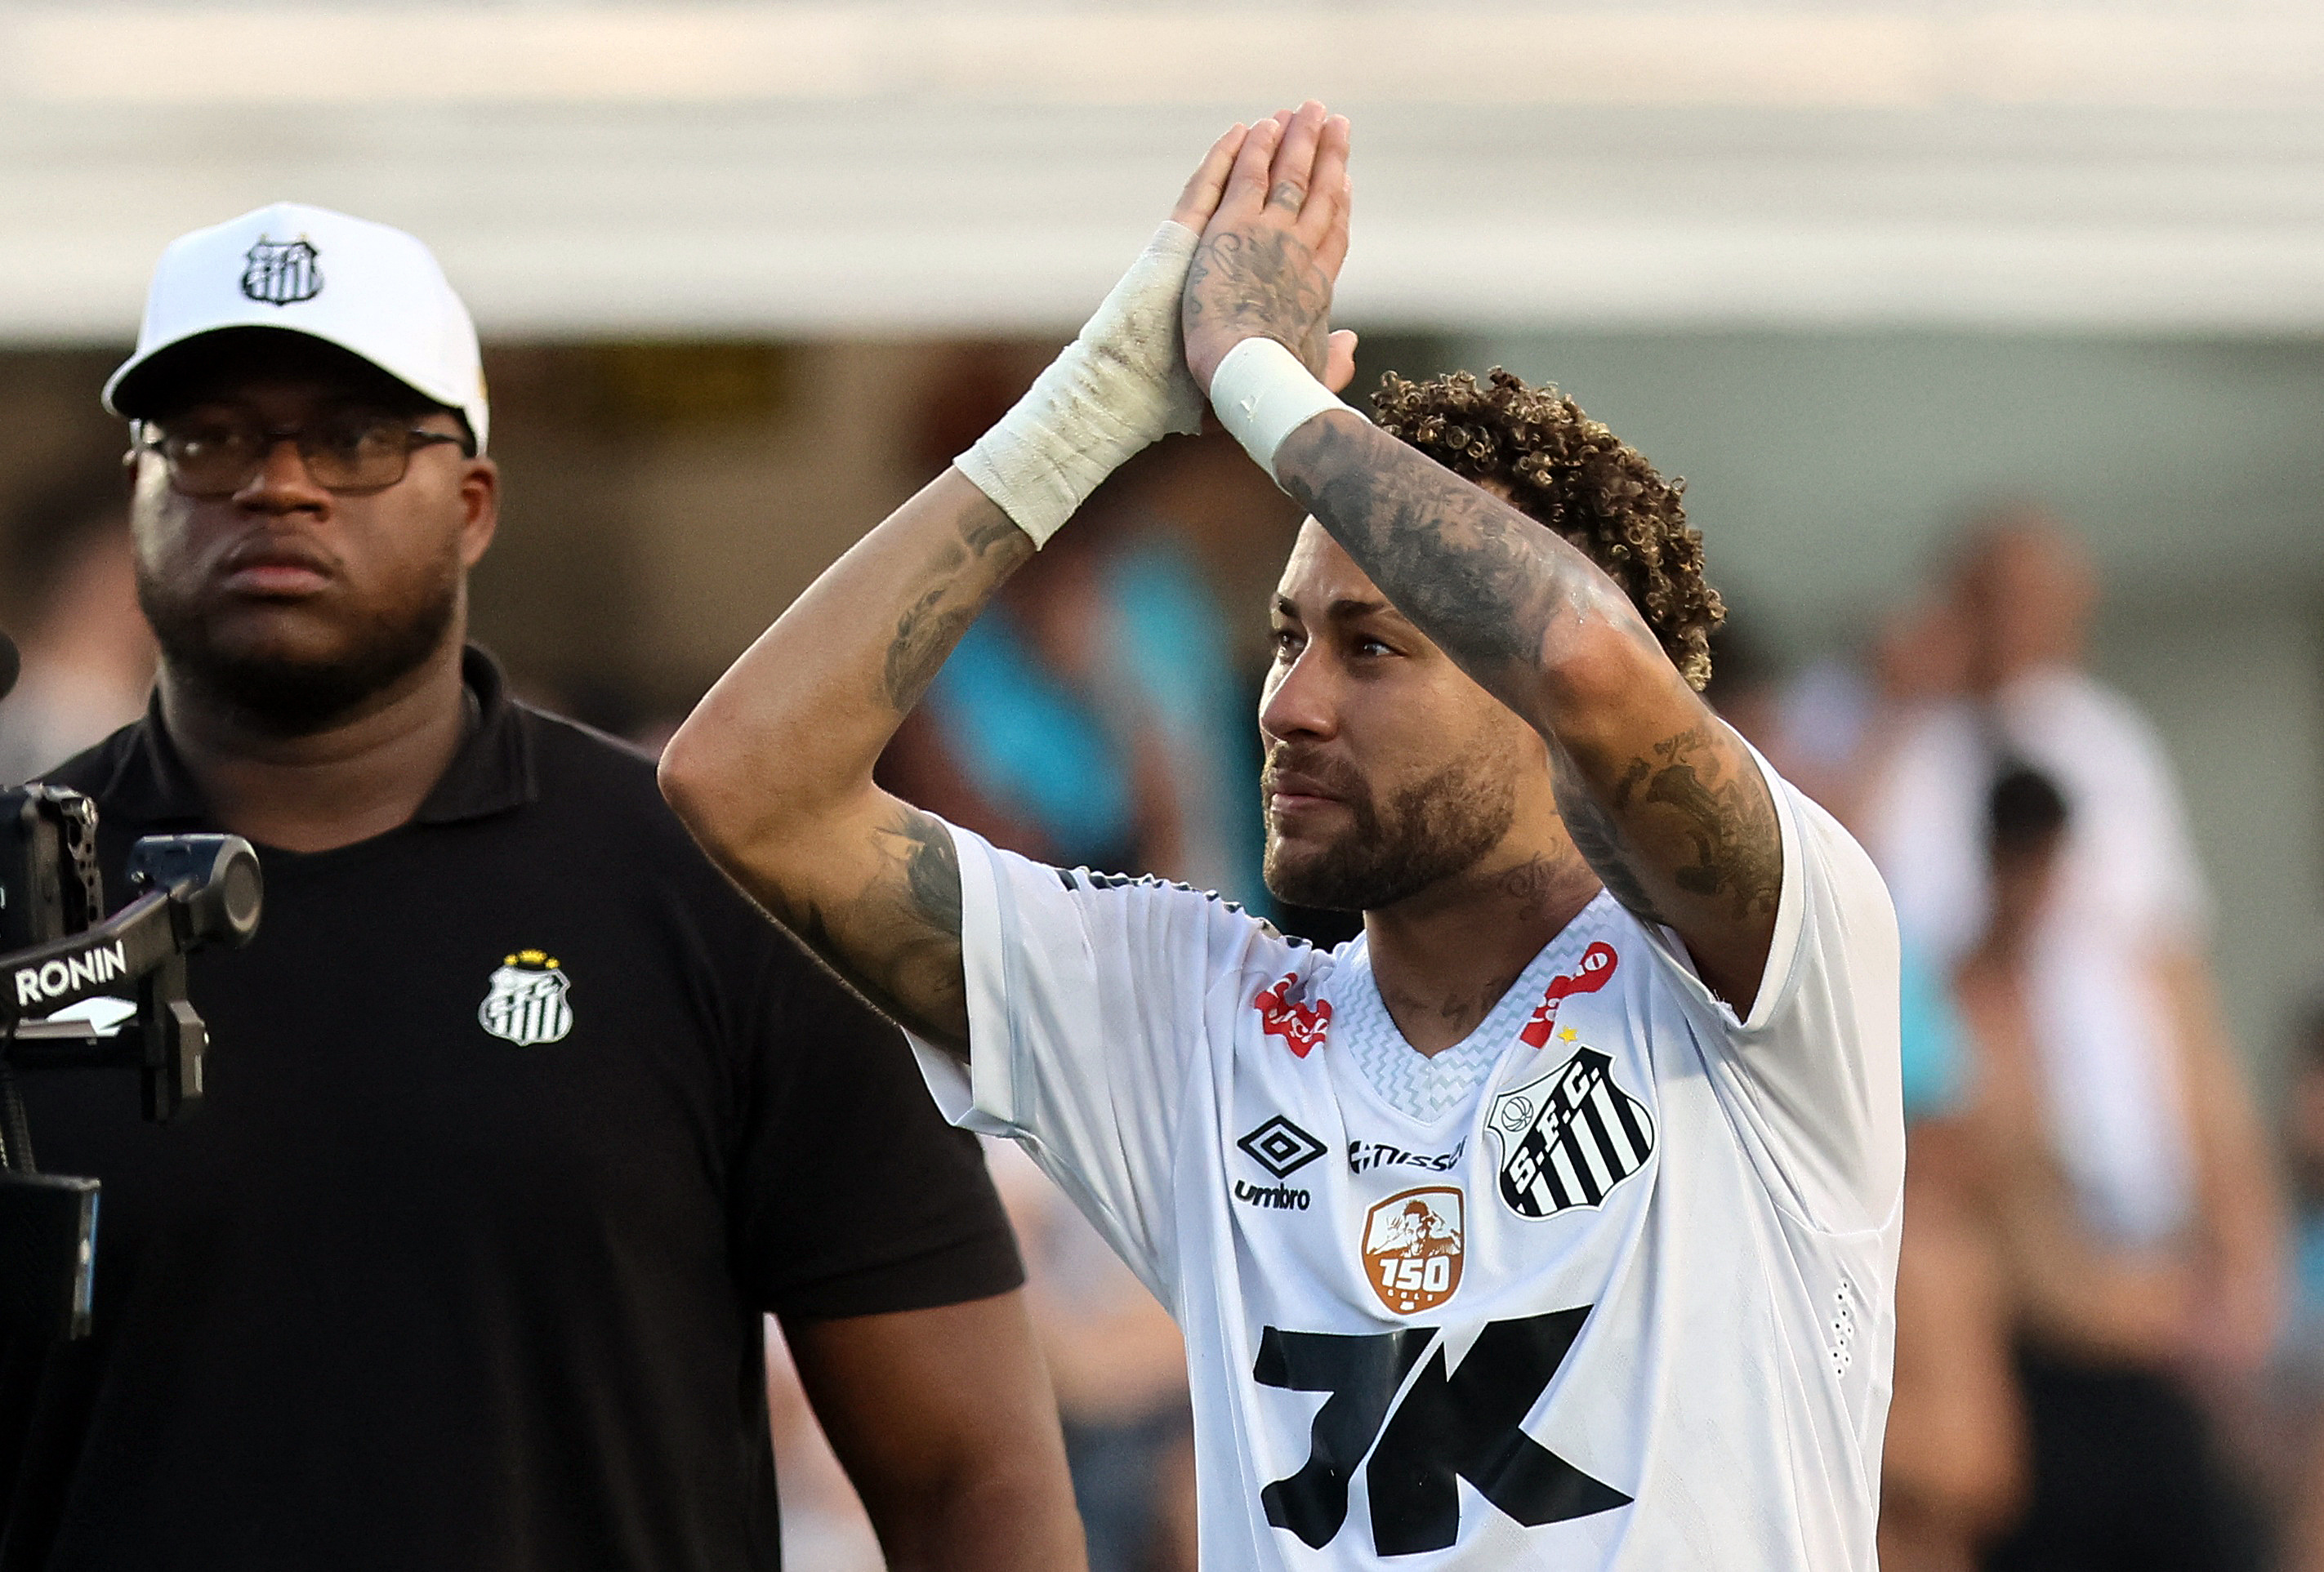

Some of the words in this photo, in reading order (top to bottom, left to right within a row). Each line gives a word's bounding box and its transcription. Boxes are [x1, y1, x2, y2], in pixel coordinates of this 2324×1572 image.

[15, 939, 127, 1006] RONIN
[1509, 1061, 1599, 1195] S.F.C.
[1234, 1179, 1311, 1210] umbro
[1380, 1255, 1450, 1292] 150
